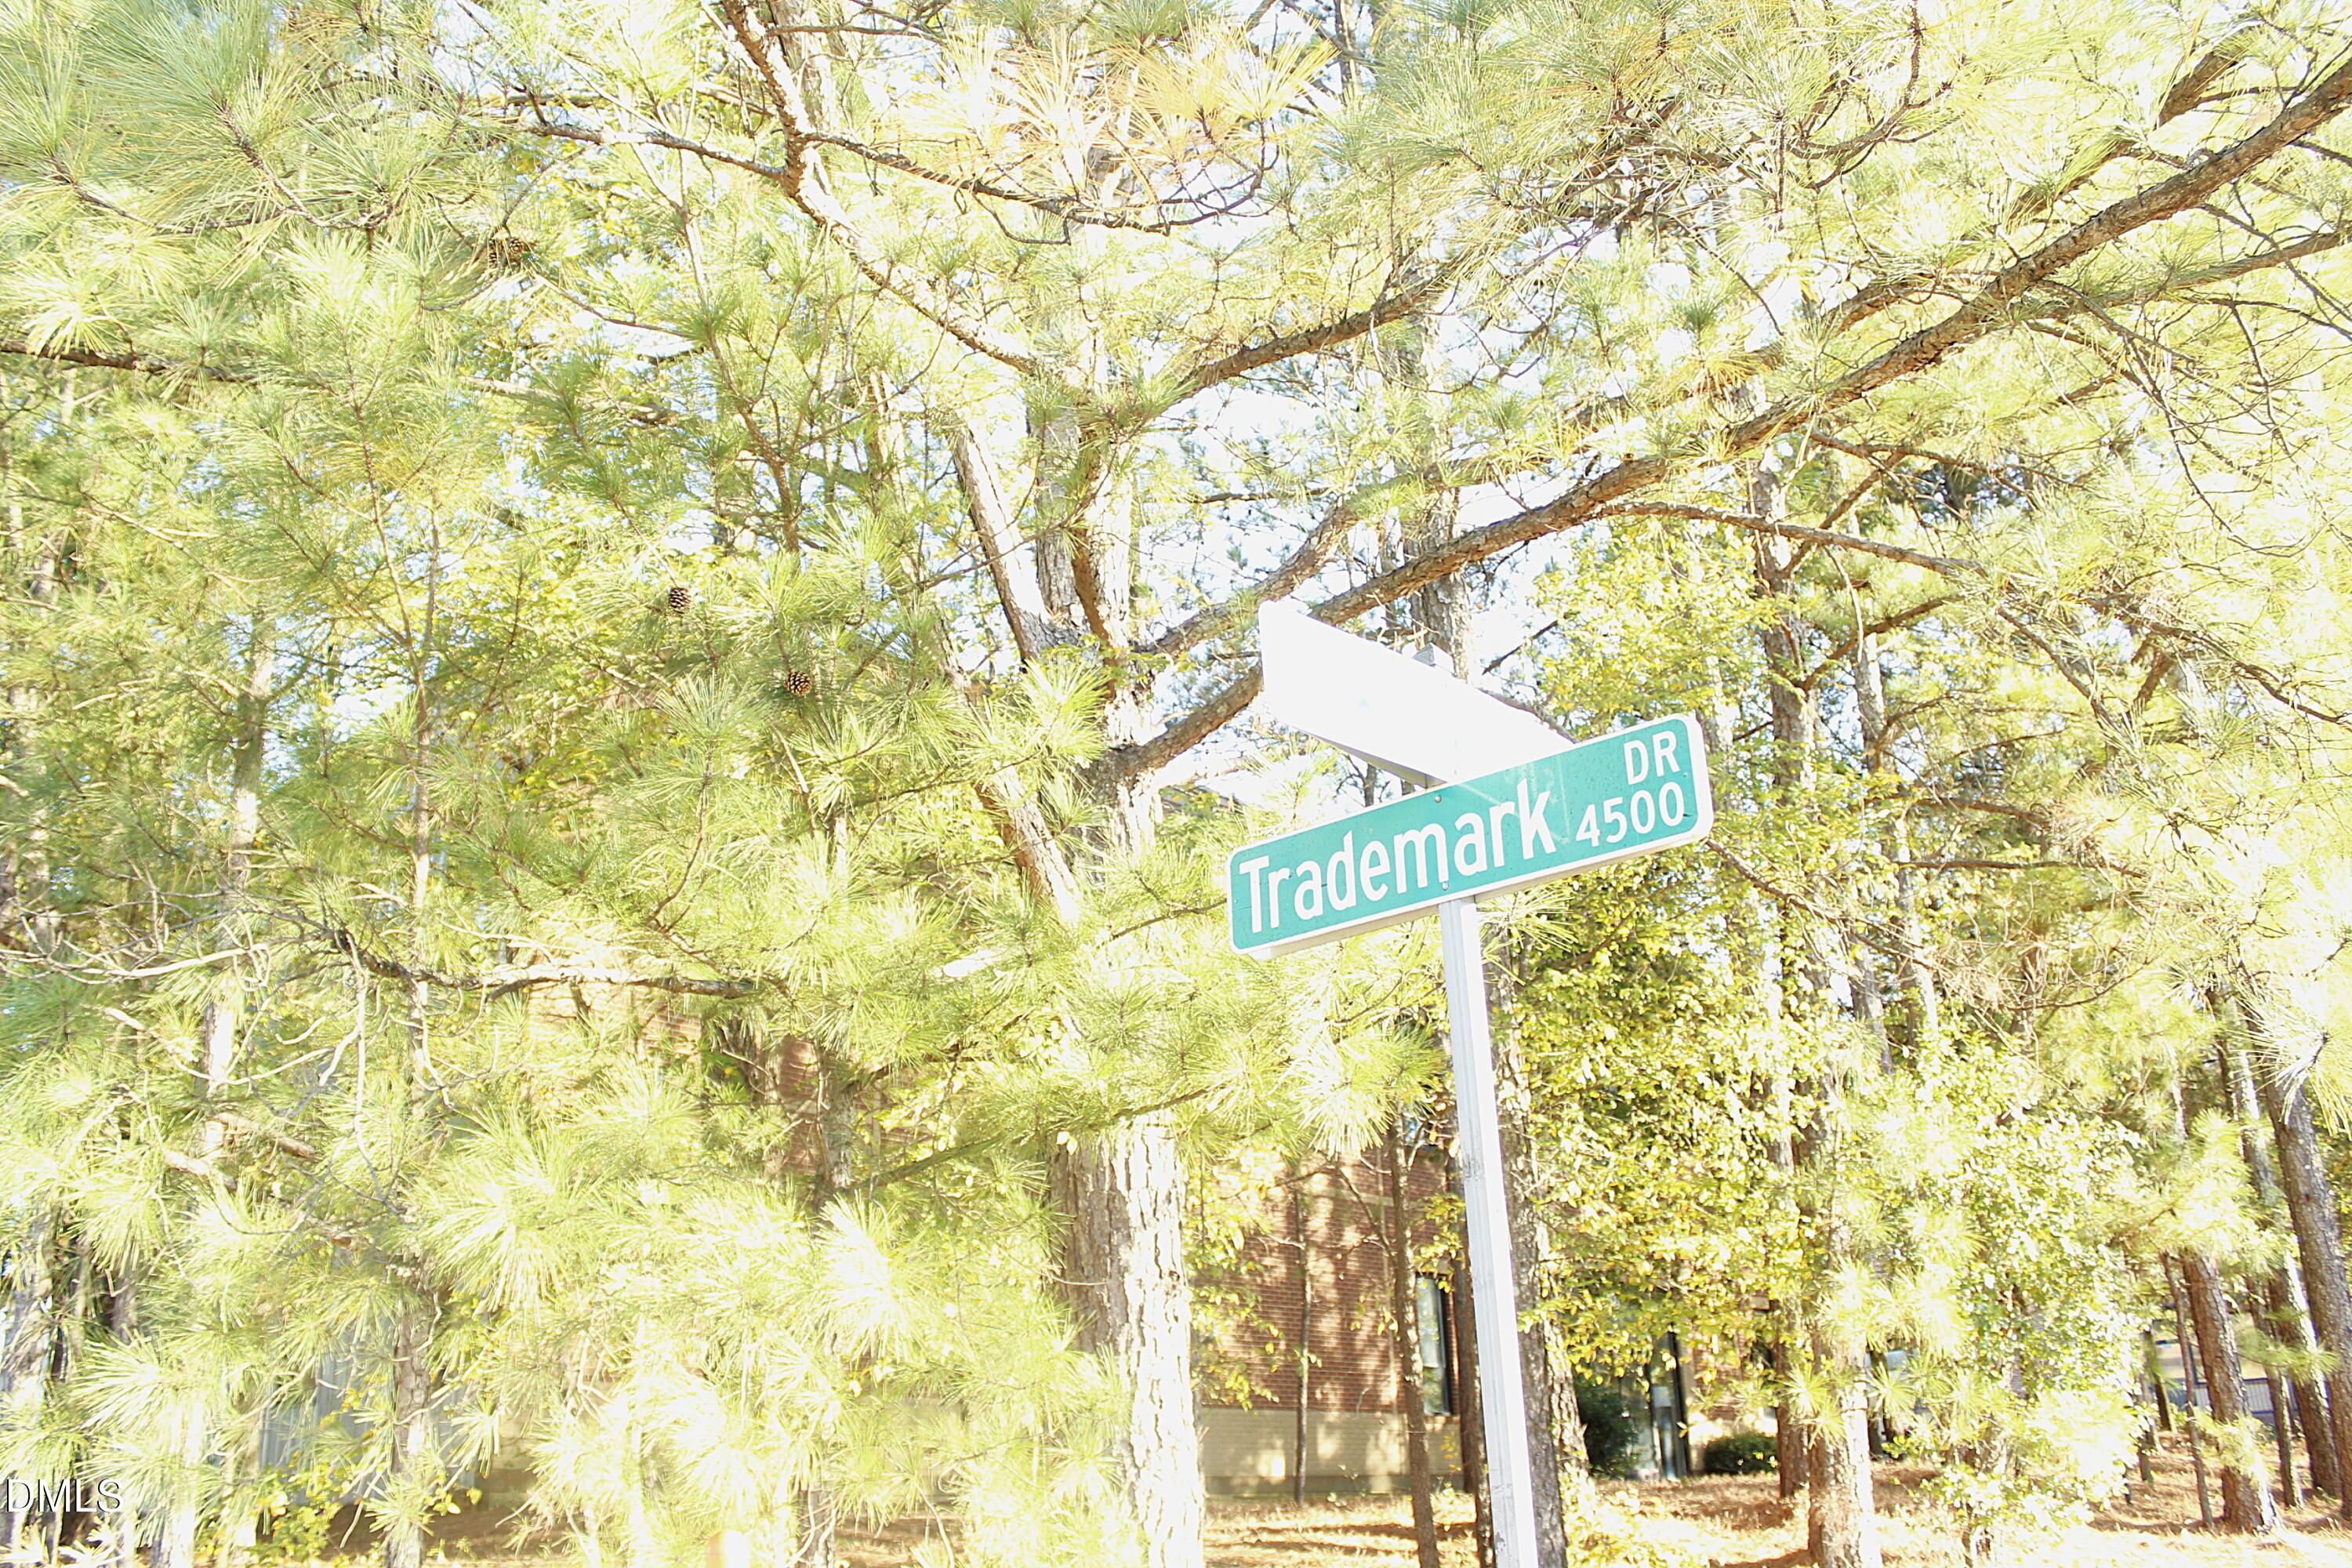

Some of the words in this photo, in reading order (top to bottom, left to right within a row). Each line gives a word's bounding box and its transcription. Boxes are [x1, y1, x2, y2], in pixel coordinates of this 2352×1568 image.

[1623, 730, 1679, 785] DR
[1240, 779, 1556, 934] Trademark
[1576, 782, 1685, 847] 4500
